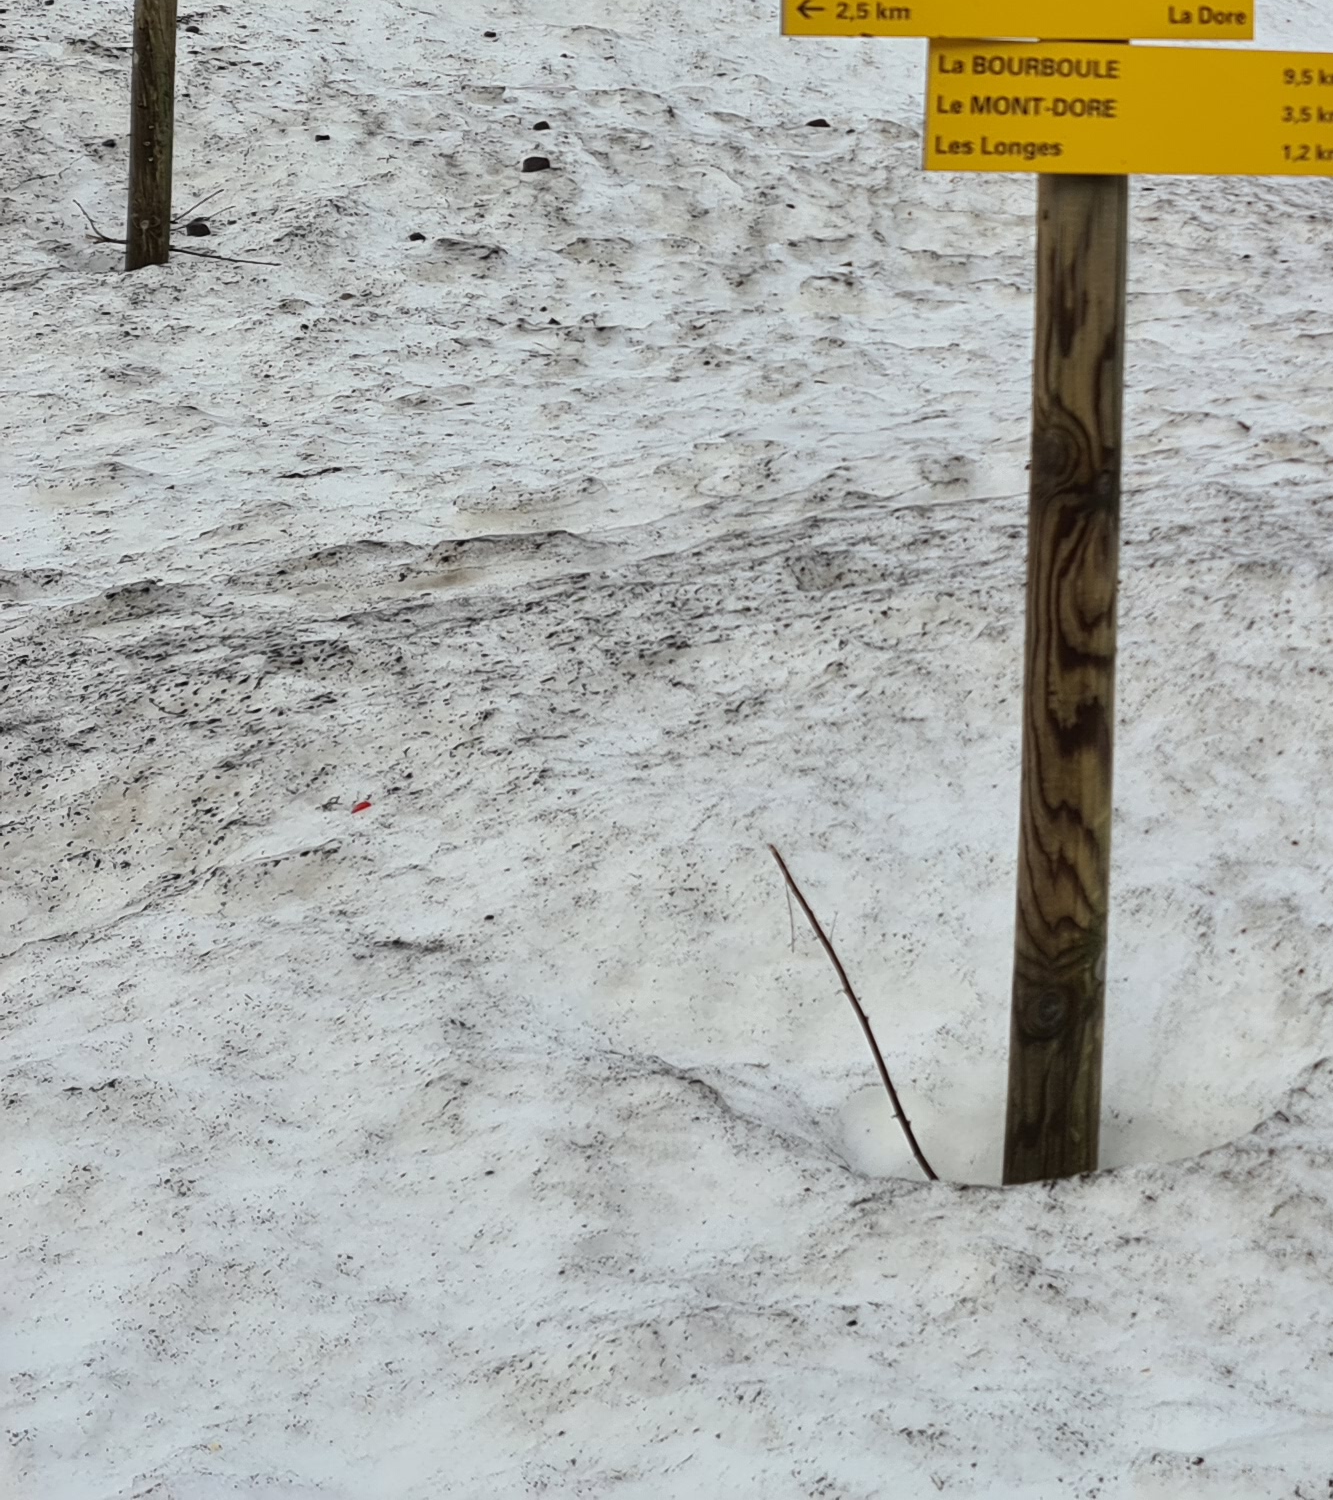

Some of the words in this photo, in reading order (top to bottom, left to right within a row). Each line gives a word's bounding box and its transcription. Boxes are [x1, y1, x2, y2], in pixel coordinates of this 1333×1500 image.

[836, 2, 870, 23] 2,5
[876, 2, 912, 21] km
[1168, 6, 1194, 24] La
[1200, 7, 1246, 26] Dore
[938, 54, 966, 76] La
[973, 55, 1120, 80] BOURBOULE
[1283, 68, 1313, 89] 9,5
[936, 95, 964, 116] Le
[970, 96, 1117, 119] MONT-DORE
[1282, 105, 1312, 127] 3,5
[935, 136, 974, 156] Les
[981, 137, 1064, 160] Longes
[1282, 143, 1311, 165] 1,2
